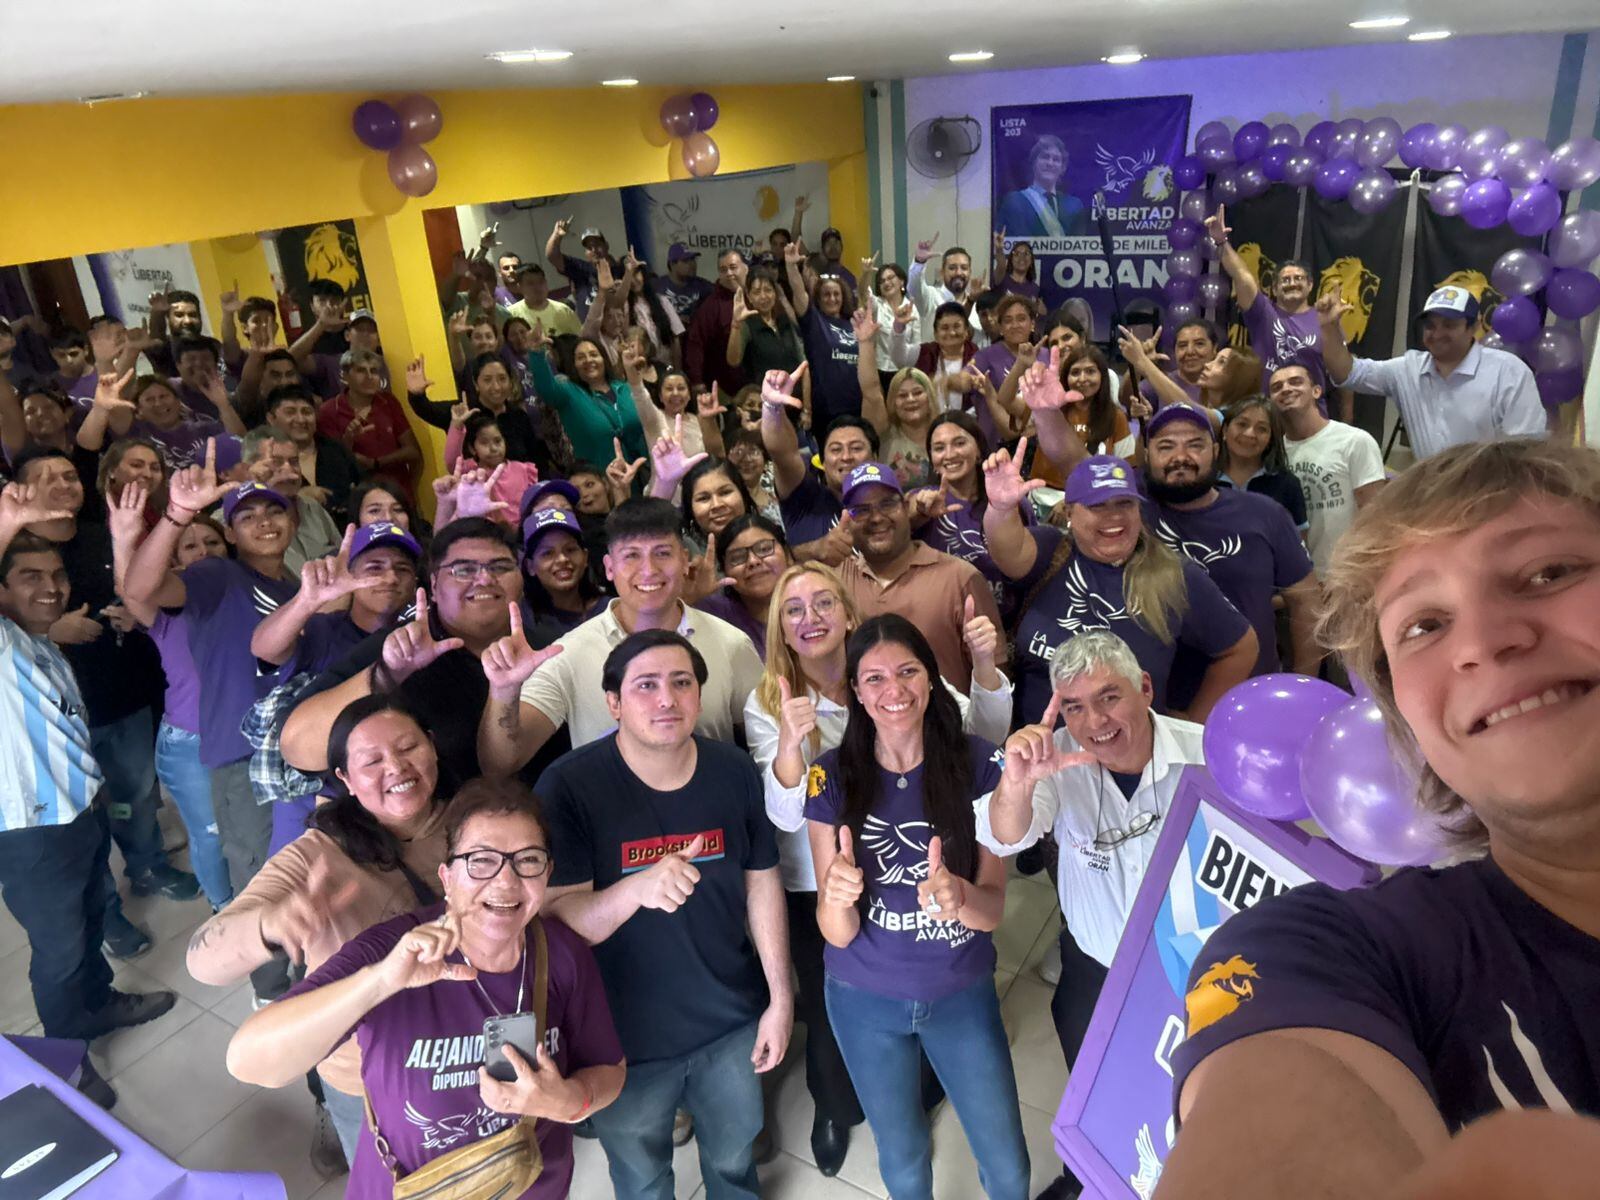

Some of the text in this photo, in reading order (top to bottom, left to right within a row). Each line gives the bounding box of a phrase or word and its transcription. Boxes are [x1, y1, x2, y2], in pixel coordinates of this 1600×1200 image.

[1000, 118, 1026, 127] LISTA
[1005, 128, 1021, 136] 203
[1091, 206, 1175, 220] LBERTAD
[1126, 220, 1172, 230] AVANZA
[687, 233, 754, 248] LIBERTAD
[1031, 239, 1104, 251] ANDIDATO
[1112, 240, 1131, 250] DE
[1033, 630, 1047, 644] LA
[869, 895, 887, 910] LA
[868, 907, 957, 931] LIBER
[915, 921, 971, 942] AVANZ
[950, 931, 976, 949] SALTA
[405, 1034, 486, 1073] ALEJAND
